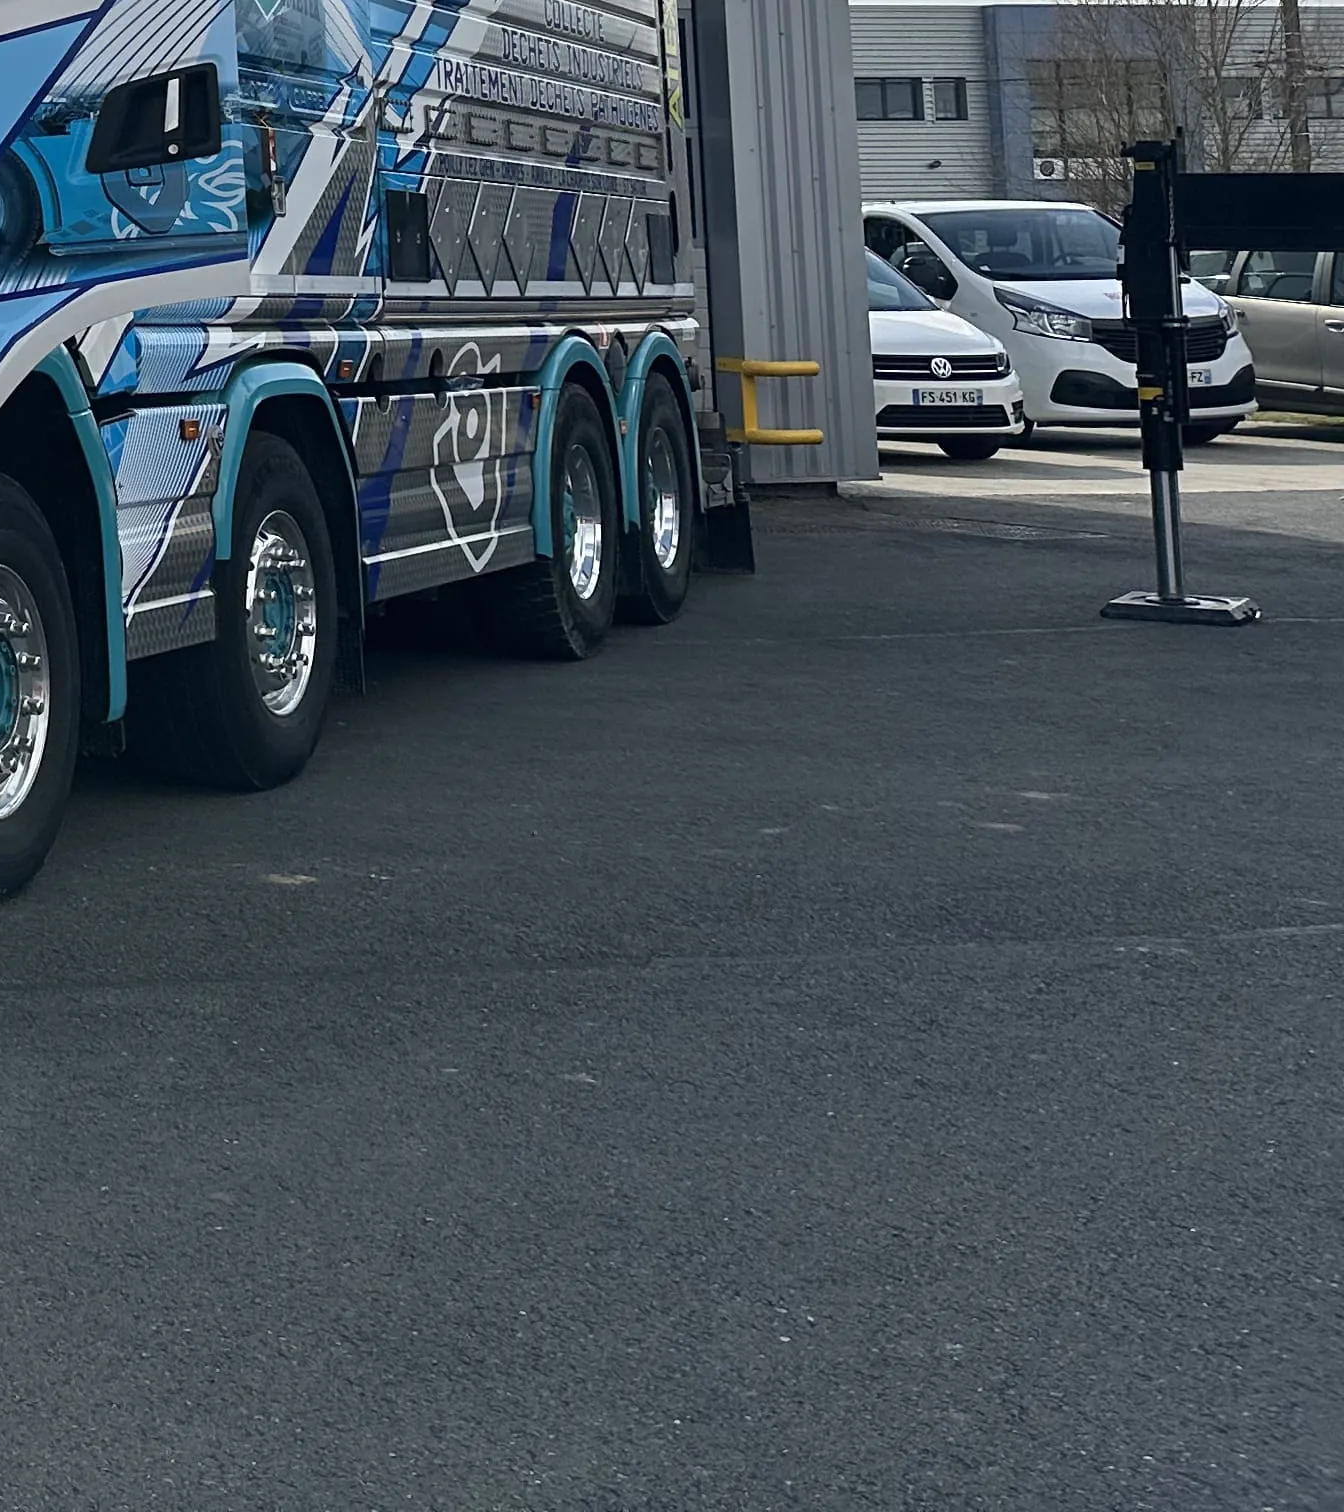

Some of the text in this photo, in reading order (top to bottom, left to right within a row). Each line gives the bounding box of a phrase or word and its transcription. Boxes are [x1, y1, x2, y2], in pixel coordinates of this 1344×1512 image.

[502, 28, 645, 90] DECHETS INDUSTRIELS
[434, 57, 660, 133] TRAITEMENT DECHETS PATHOGENES
